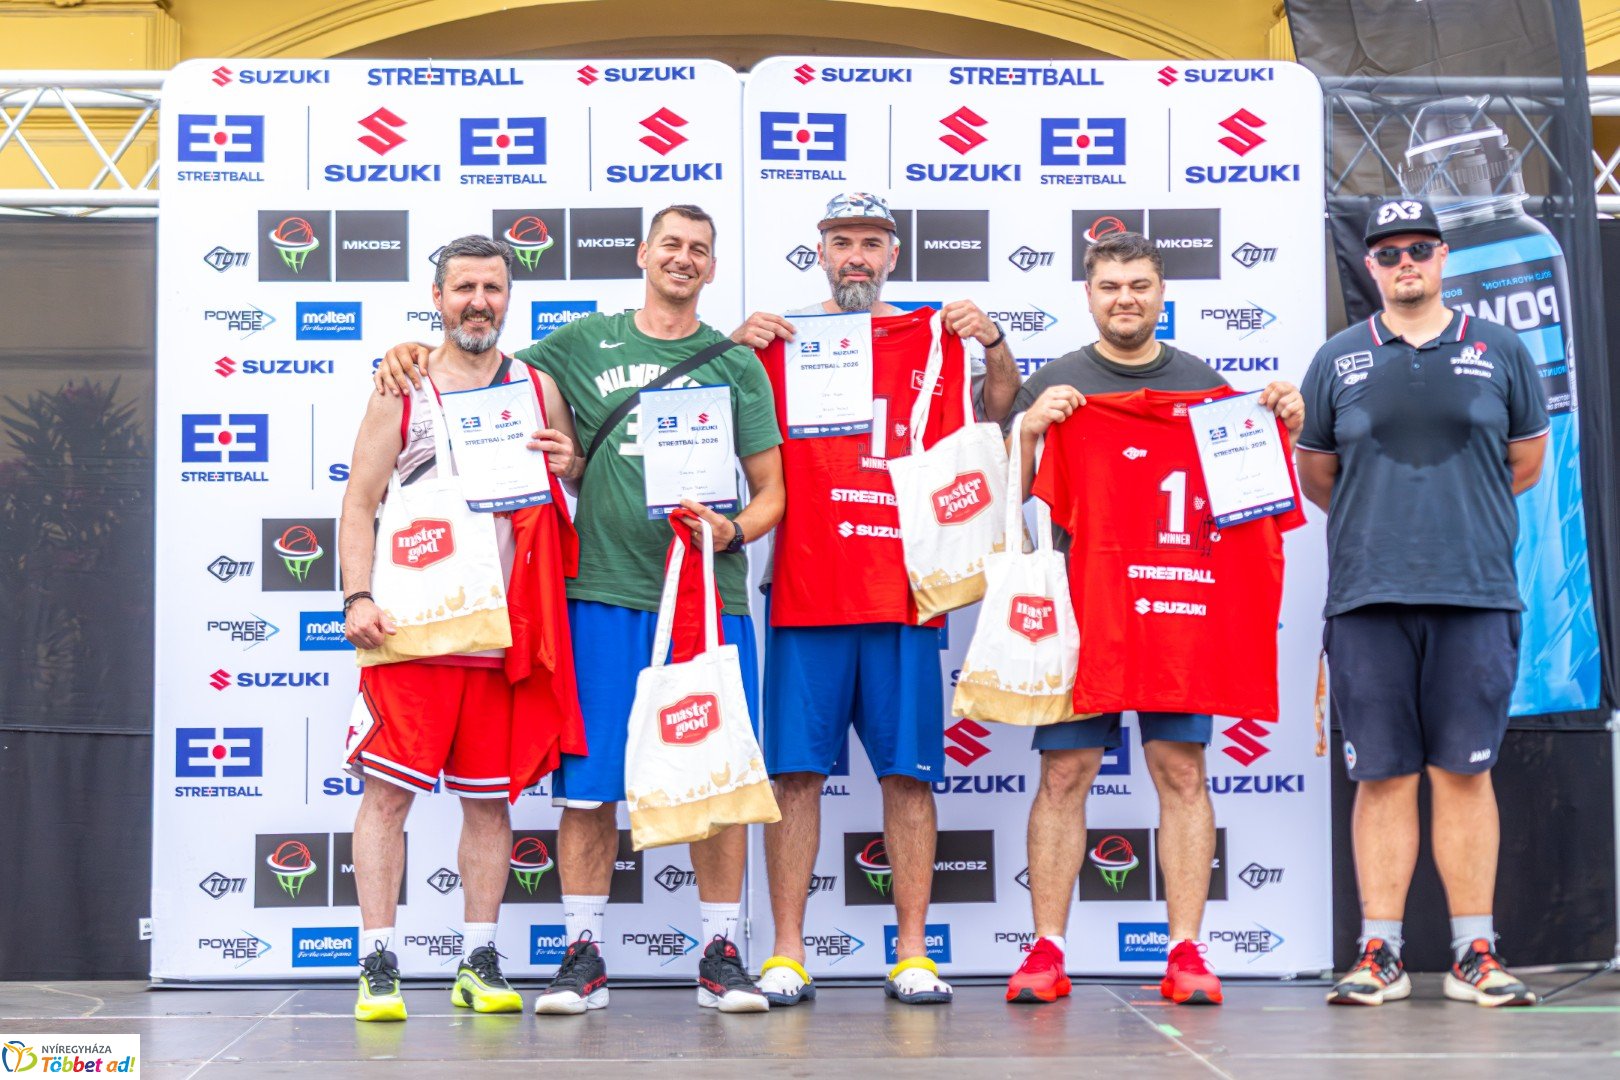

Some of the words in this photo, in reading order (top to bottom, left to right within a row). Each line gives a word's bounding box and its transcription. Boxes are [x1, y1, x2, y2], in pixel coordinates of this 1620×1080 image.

[239, 70, 330, 84] SUZUKI
[604, 67, 696, 82] SUZUKI
[822, 68, 912, 83] SUZUKI
[1184, 68, 1274, 83] SUZUKI
[324, 164, 441, 182] SUZUKI
[606, 163, 722, 183] SUZUKI
[906, 164, 1021, 182] SUZUKI
[1185, 164, 1300, 184] SUZUKI
[342, 240, 401, 250] MKOSZ
[578, 238, 636, 248] MKOSZ
[924, 240, 982, 250] MKOSZ
[1156, 238, 1214, 248] MKOSZ
[214, 252, 251, 267] TOTI
[1019, 252, 1056, 267] TOTI
[1242, 247, 1278, 262] TOTI
[204, 310, 264, 320] POWER
[303, 311, 354, 324] molten
[407, 311, 442, 321] POW
[987, 311, 1045, 321] POWER
[1201, 309, 1263, 318] POWER
[228, 321, 264, 331] ADE
[1010, 322, 1045, 332] ADE
[1226, 320, 1263, 330] ADE
[242, 360, 334, 374] SUZUKI
[1206, 358, 1279, 372] UZUKI
[507, 432, 524, 440] 2026
[862, 457, 889, 471] WINNE
[831, 488, 899, 507] STREETB
[1160, 471, 1186, 533] 1
[857, 524, 902, 539] SUZU
[1158, 533, 1190, 546] WINNER
[218, 561, 255, 577] TOTI
[1152, 602, 1206, 616] SUZUKI
[208, 620, 266, 631] POWER
[307, 621, 346, 634] molte
[232, 631, 266, 642] ADE
[237, 672, 328, 687] SUZUKI
[324, 777, 441, 796] SUI
[932, 774, 1026, 794] UZUKI
[1089, 784, 1131, 796] TBALL
[933, 861, 987, 870] MKOSZ
[1250, 868, 1285, 883] TOTI
[210, 878, 247, 894] TOTI
[199, 938, 259, 948] POWER
[300, 936, 352, 950] molten
[404, 935, 464, 946] POWER
[538, 935, 568, 948] mol
[622, 934, 684, 944] POWER
[804, 935, 851, 946] OWER
[995, 932, 1036, 942] POW
[1125, 932, 1169, 944] molte
[1210, 932, 1271, 942] POWER
[222, 948, 259, 958] ADE
[429, 946, 464, 956] ADE
[648, 945, 684, 956] ADE
[816, 946, 851, 956] ADE
[1234, 942, 1271, 952] ADE
